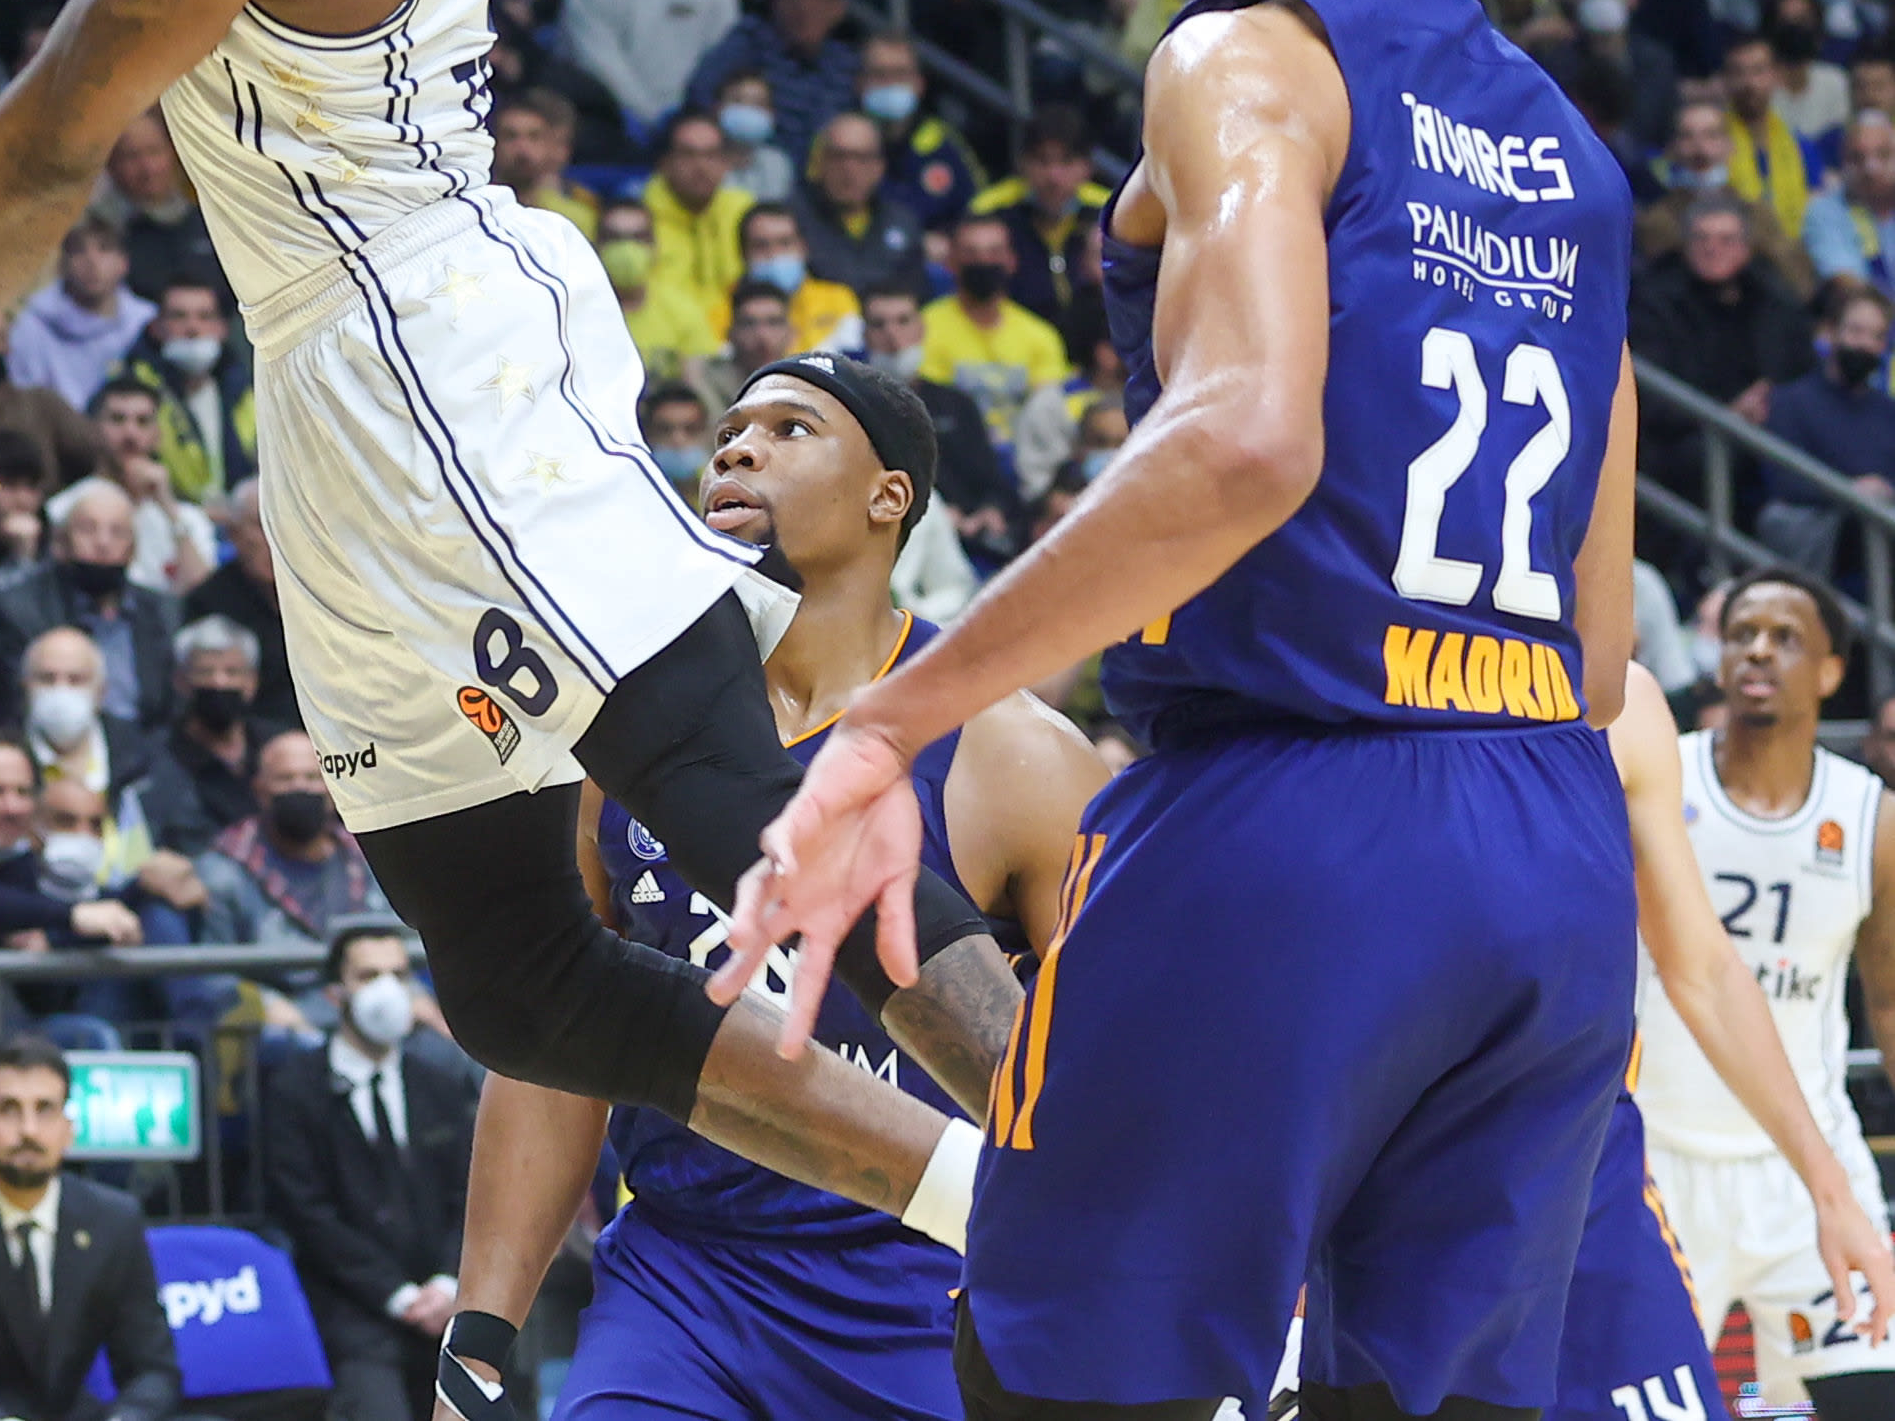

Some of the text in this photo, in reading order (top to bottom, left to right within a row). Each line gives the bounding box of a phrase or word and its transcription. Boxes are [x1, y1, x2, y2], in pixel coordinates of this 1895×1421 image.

[1413, 259, 1474, 302] HOTEL
[1391, 326, 1572, 621] 22
[473, 607, 558, 716] 8
[1383, 625, 1580, 722] MADRID
[316, 741, 377, 779] apyd
[1714, 870, 1792, 945] 21
[157, 1266, 263, 1330] pyd
